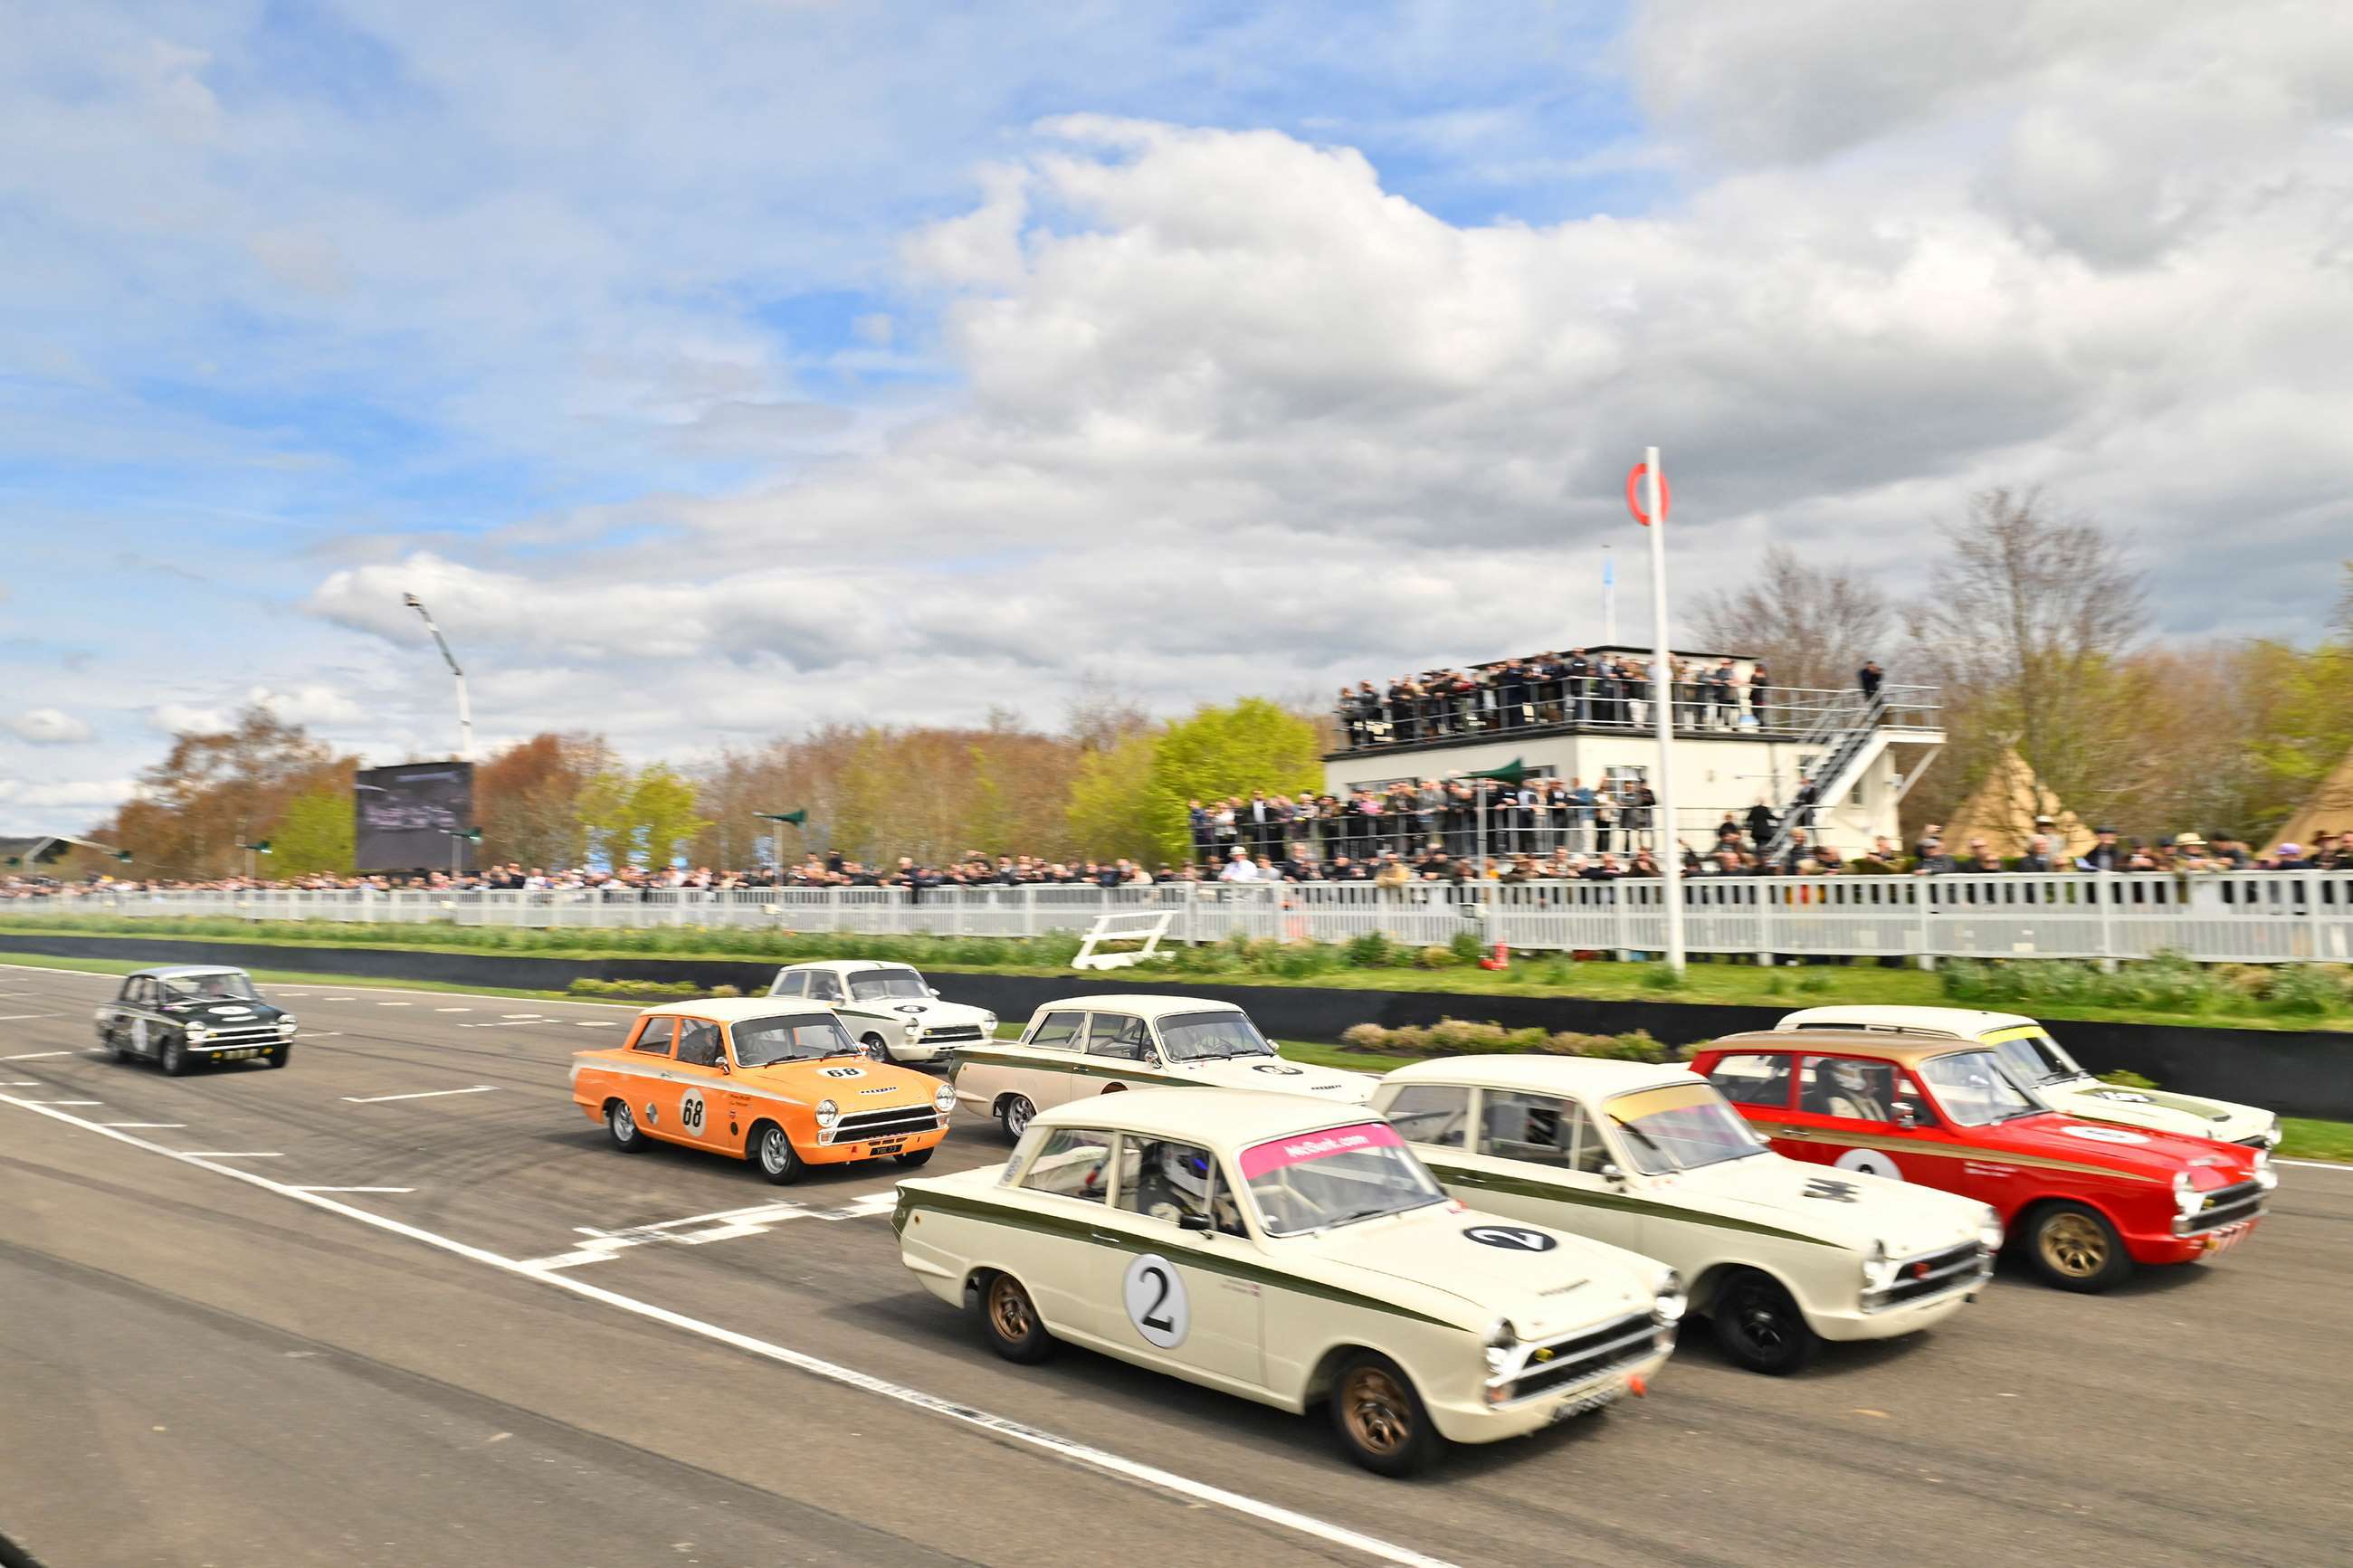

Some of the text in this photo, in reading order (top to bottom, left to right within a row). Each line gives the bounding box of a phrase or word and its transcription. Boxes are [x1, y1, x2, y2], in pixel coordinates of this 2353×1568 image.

[826, 1068, 860, 1077] 68
[682, 1098, 703, 1127] 68
[1470, 1229, 1544, 1250] 2
[1138, 1266, 1174, 1333] 2
